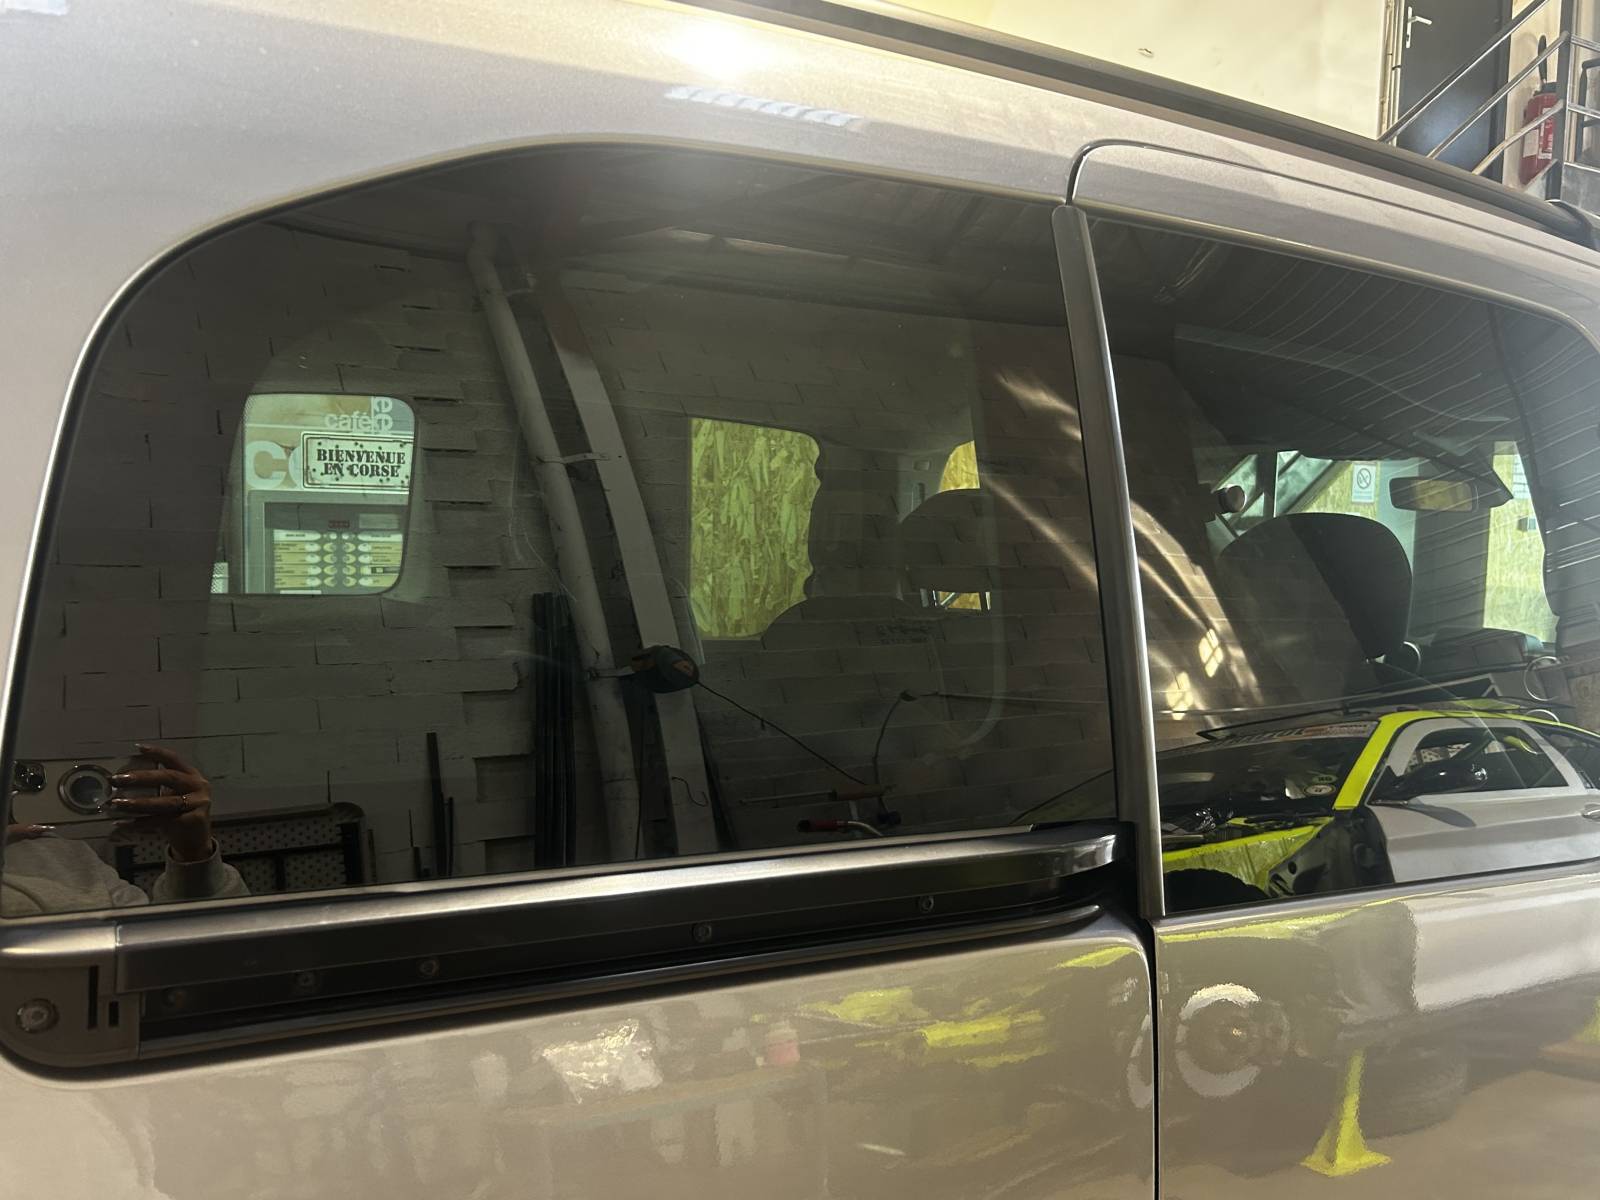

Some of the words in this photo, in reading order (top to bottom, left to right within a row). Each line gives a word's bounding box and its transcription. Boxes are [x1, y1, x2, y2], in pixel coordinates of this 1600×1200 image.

[317, 449, 405, 464] BIENVENUE
[324, 463, 343, 476] EN
[350, 464, 399, 477] CORSE
